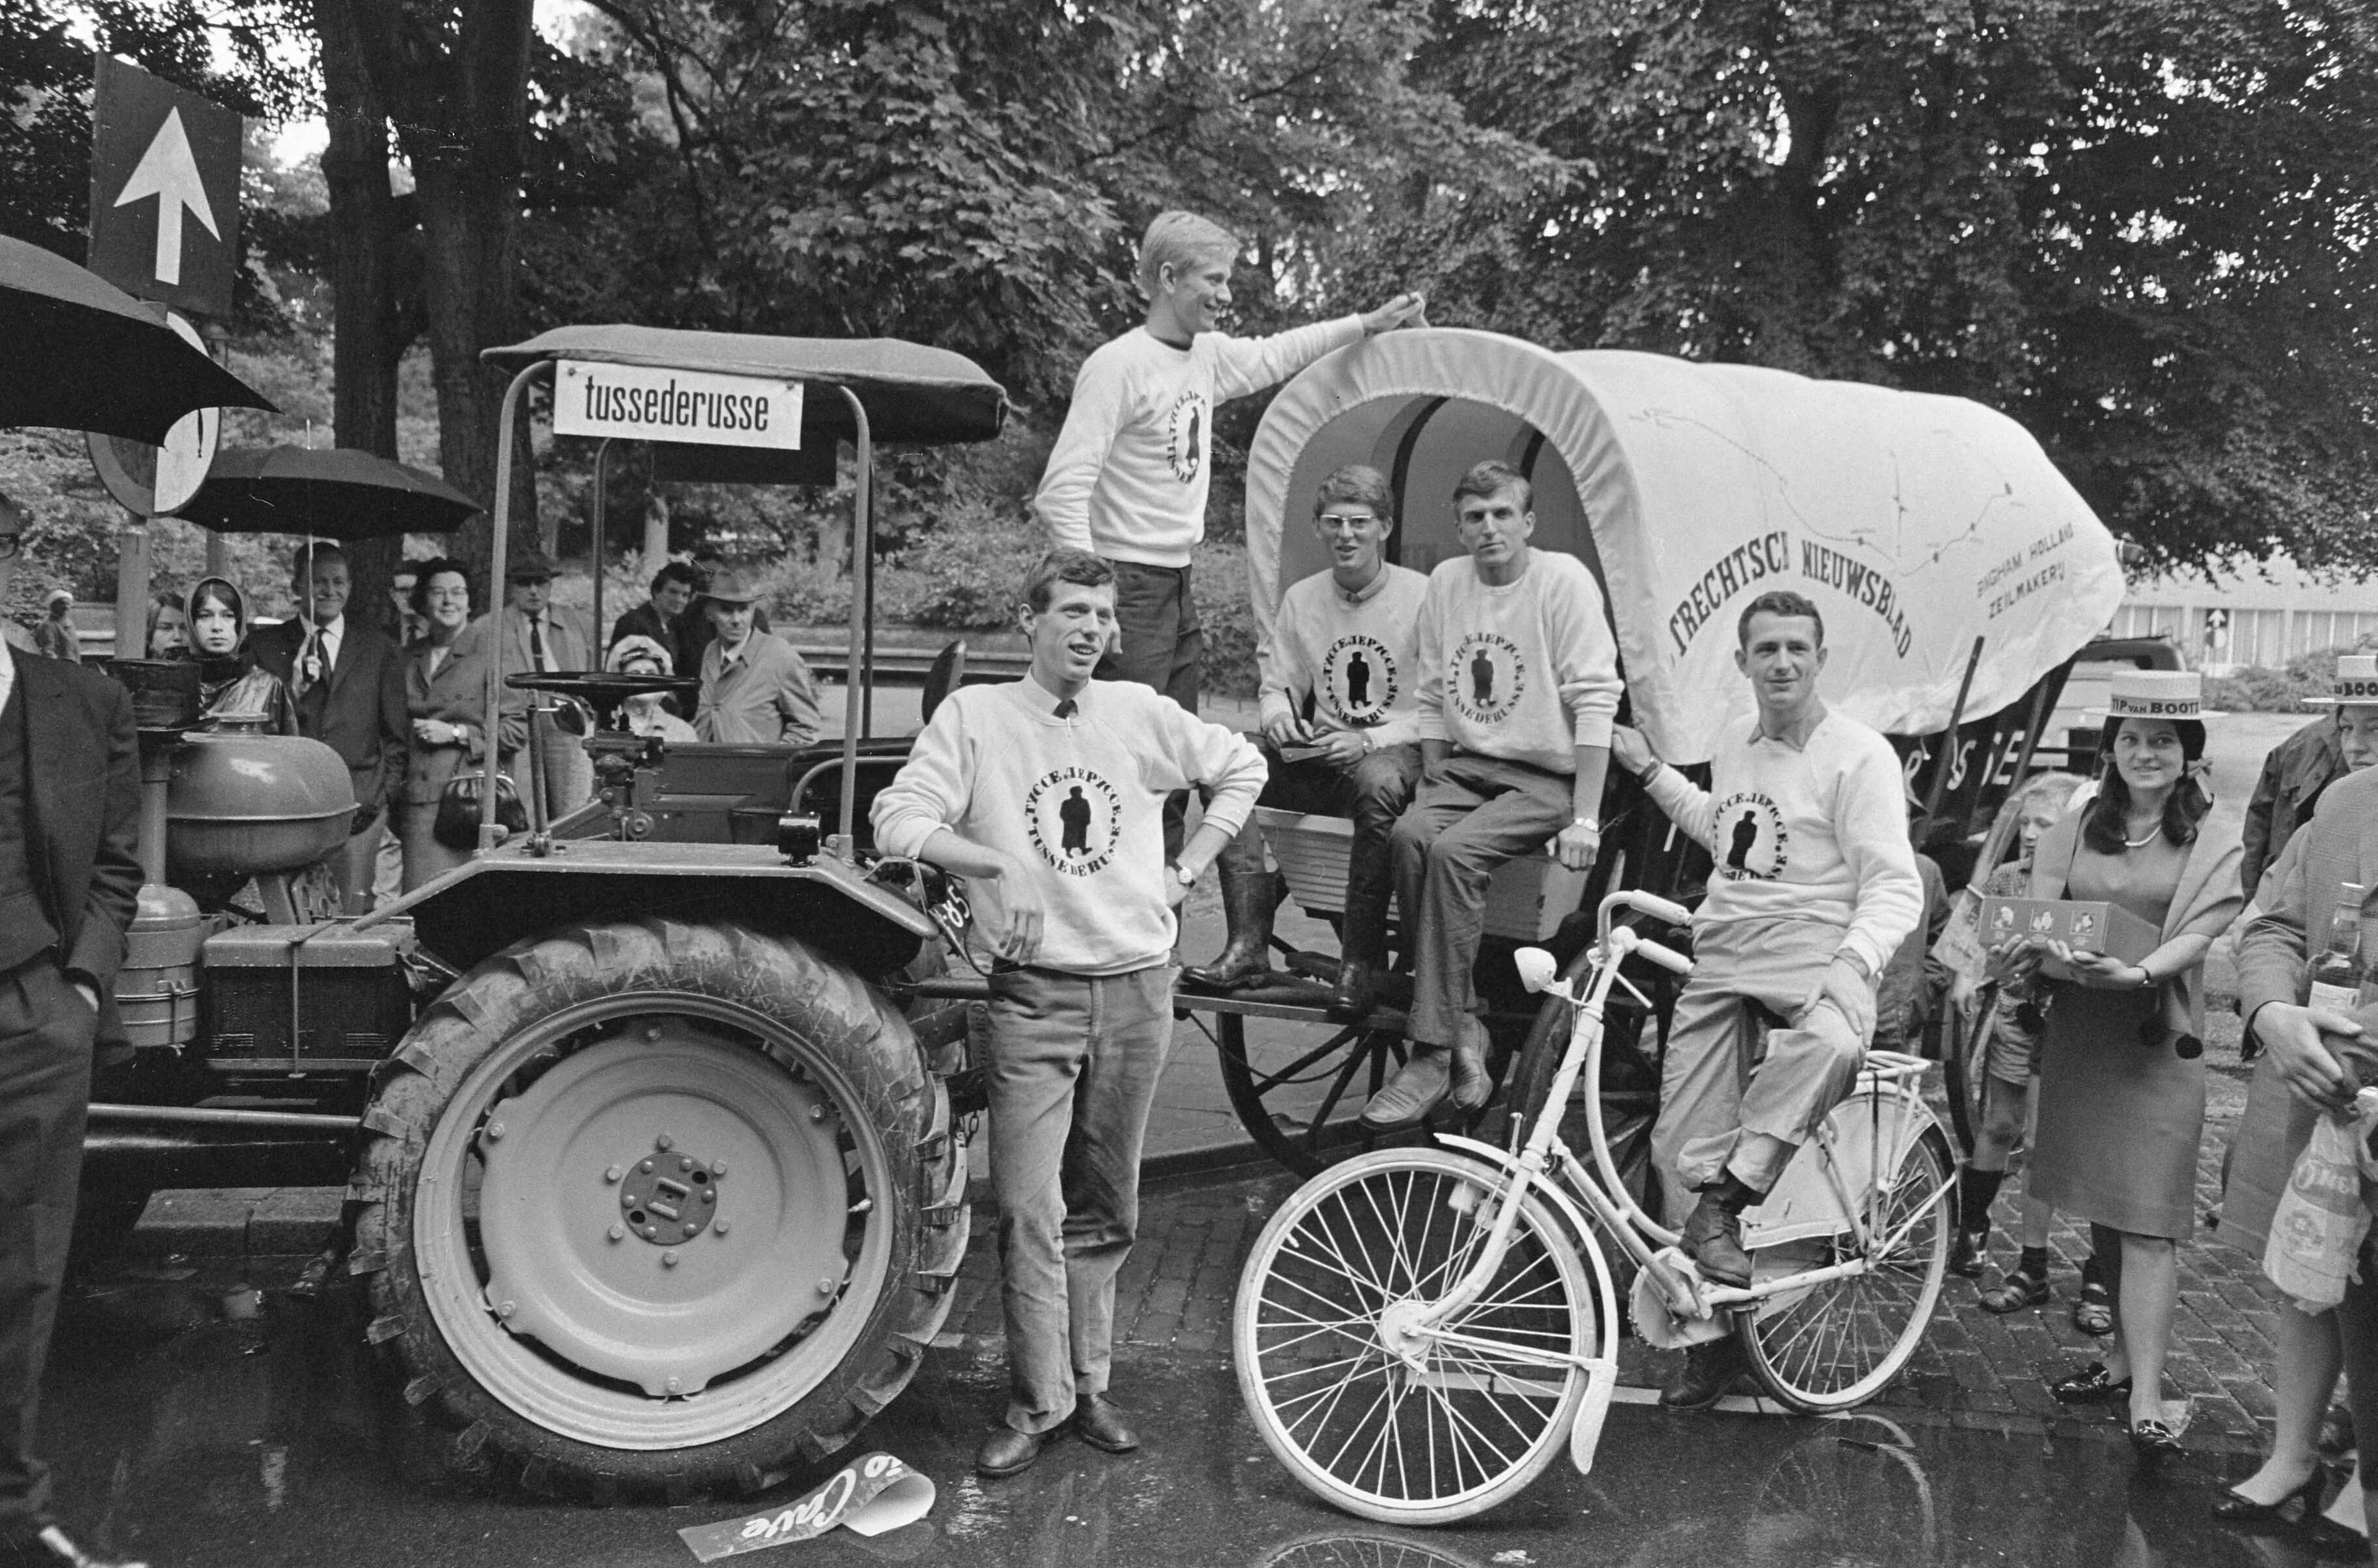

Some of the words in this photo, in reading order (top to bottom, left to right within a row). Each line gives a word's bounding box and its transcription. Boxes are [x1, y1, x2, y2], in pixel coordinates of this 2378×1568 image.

[585, 375, 769, 431] tussederusse
[1801, 540, 1912, 658] NIEUWSBLAD
[2112, 698, 2127, 710] TIP
